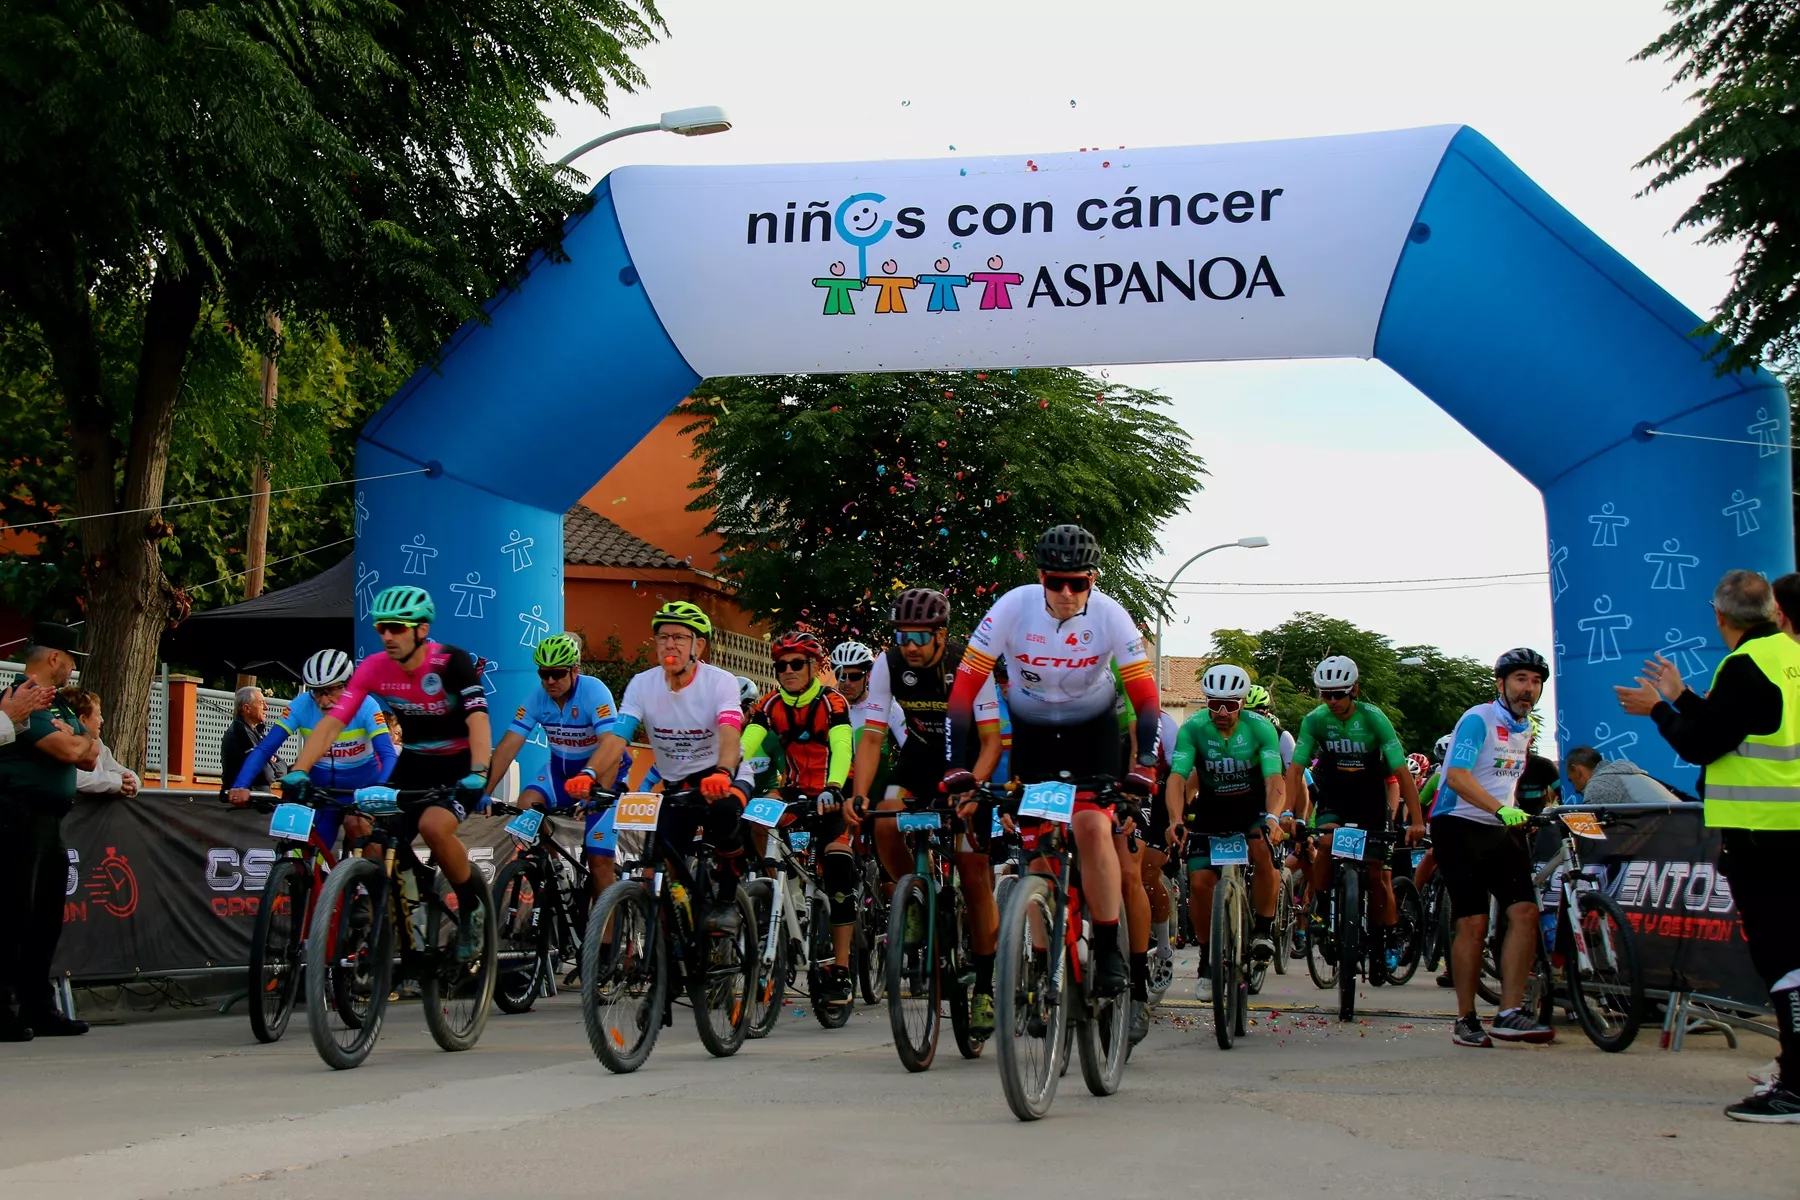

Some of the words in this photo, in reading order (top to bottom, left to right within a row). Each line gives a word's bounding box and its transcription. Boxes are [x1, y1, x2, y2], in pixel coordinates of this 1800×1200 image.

[947, 198, 1053, 237] con
[1076, 186, 1284, 231] cáncer
[1027, 255, 1285, 308] ASPANOA
[1015, 653, 1099, 669] ACTUR
[1326, 738, 1369, 754] PEDAL
[1205, 757, 1253, 774] PEDAL
[1213, 771, 1249, 782] STORE
[1027, 790, 1067, 805] 306
[620, 802, 656, 816] 1008
[753, 803, 771, 816] 61
[289, 814, 296, 827] 1
[1214, 841, 1243, 854] 426
[1336, 835, 1360, 850] 293
